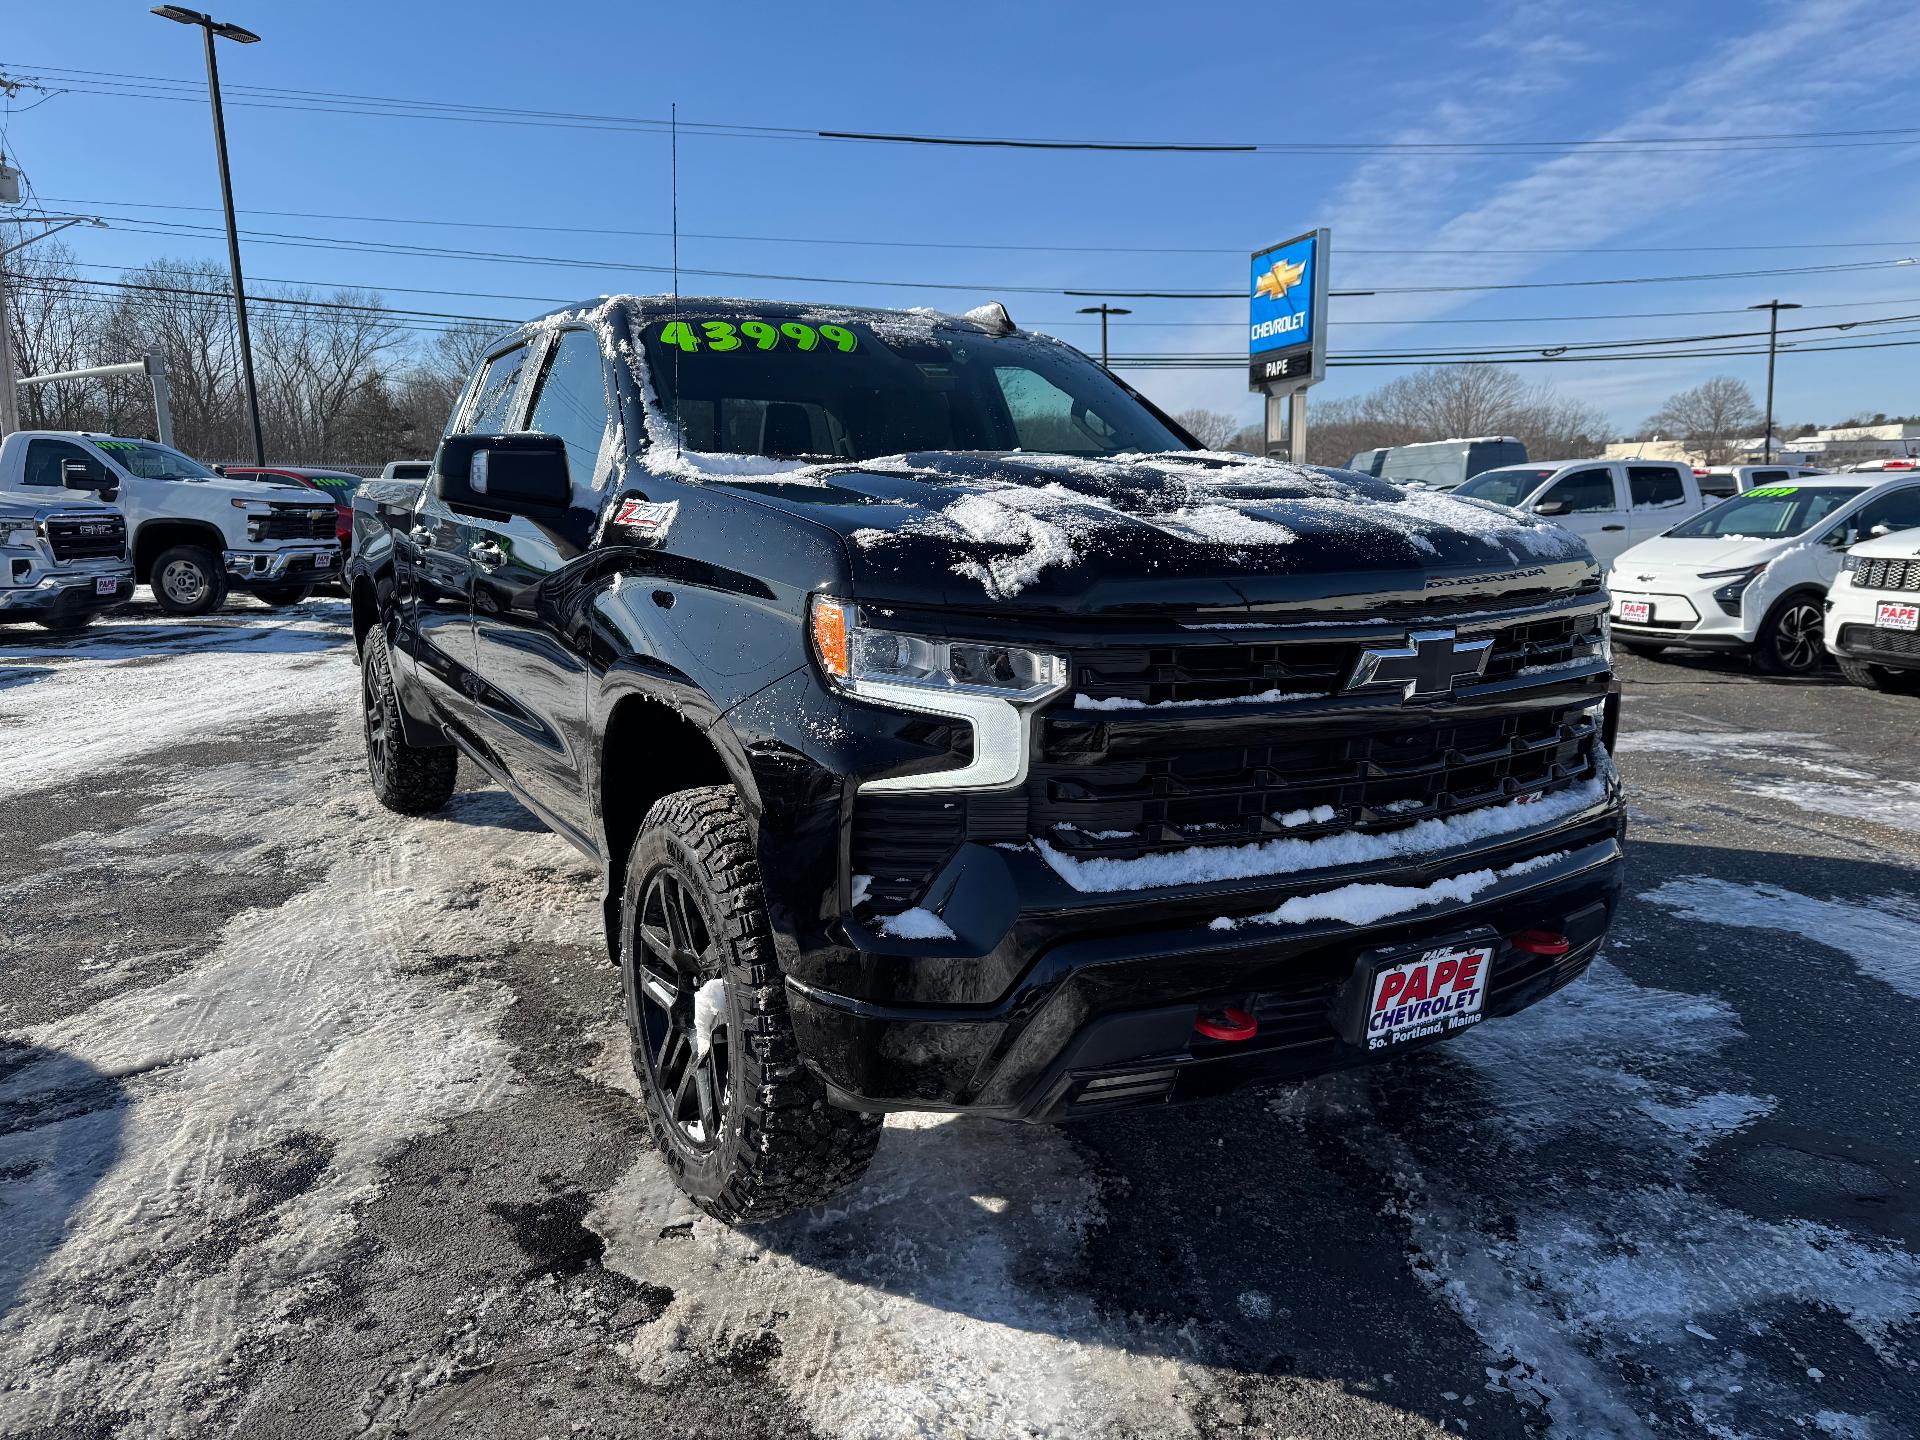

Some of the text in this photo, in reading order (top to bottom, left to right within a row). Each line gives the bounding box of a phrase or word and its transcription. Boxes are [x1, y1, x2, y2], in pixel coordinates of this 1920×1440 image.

[660, 321, 858, 353] 43999
[1251, 312, 1305, 340] CHEVROLET
[1266, 359, 1288, 377] PAPE
[80, 525, 112, 535] GMC
[1624, 604, 1648, 613] PAPE
[1881, 607, 1916, 619] PAPE
[1421, 946, 1455, 962] PAPE
[1375, 954, 1483, 1011] PAPE
[1369, 988, 1480, 1031] CHEVROLET
[1369, 1038, 1388, 1050] So.
[1392, 1021, 1444, 1044] Portland,
[1448, 1013, 1482, 1029] Maine
